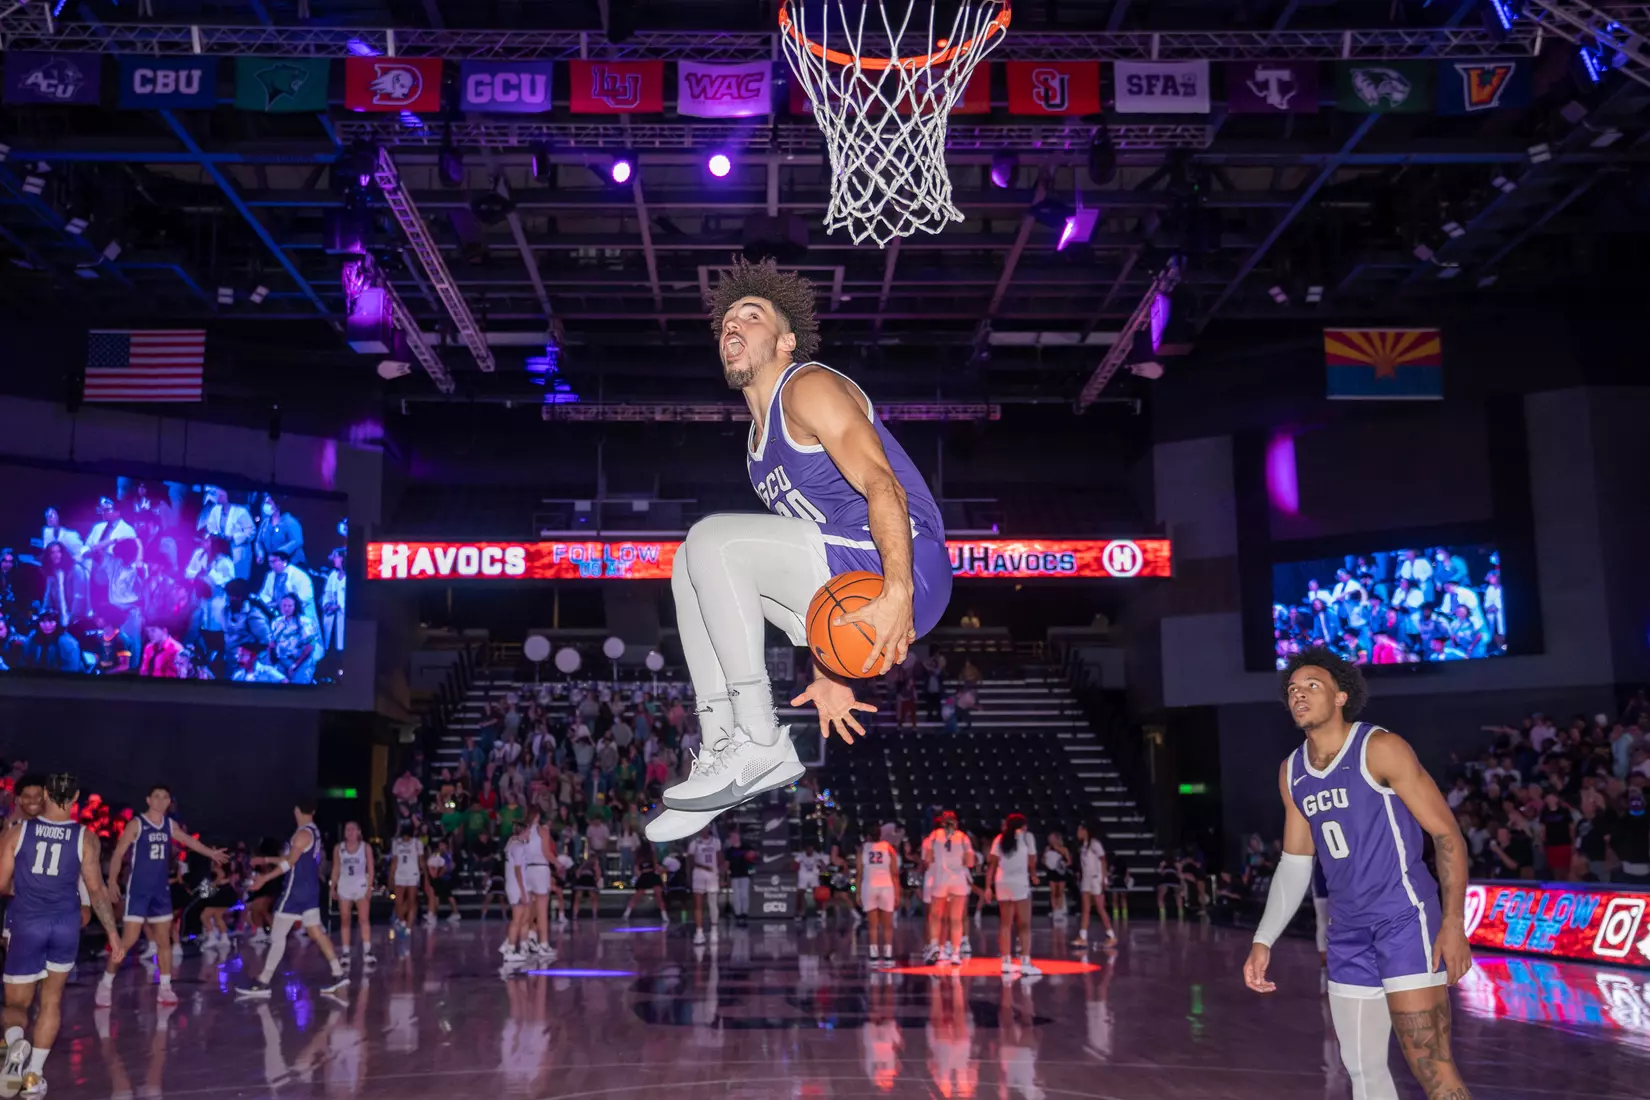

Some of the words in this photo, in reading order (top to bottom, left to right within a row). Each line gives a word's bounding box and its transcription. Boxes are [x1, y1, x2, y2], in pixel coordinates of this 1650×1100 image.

[25, 71, 75, 98] ACU
[134, 69, 202, 94] CBU
[467, 73, 547, 104] GCU
[592, 65, 641, 108] LU
[685, 72, 765, 100] WAC
[1033, 68, 1069, 111] SU
[1127, 74, 1180, 96] SFA
[758, 465, 792, 510] GCU
[379, 544, 526, 578] HAVOCS
[553, 544, 660, 564] FOLLOW
[1302, 788, 1350, 817] GCU
[35, 823, 65, 840] WOODS
[1321, 820, 1350, 860] 0
[31, 841, 62, 876] 11
[150, 844, 165, 860] 21
[868, 851, 884, 864] 22
[1489, 889, 1600, 929] FOLLOW
